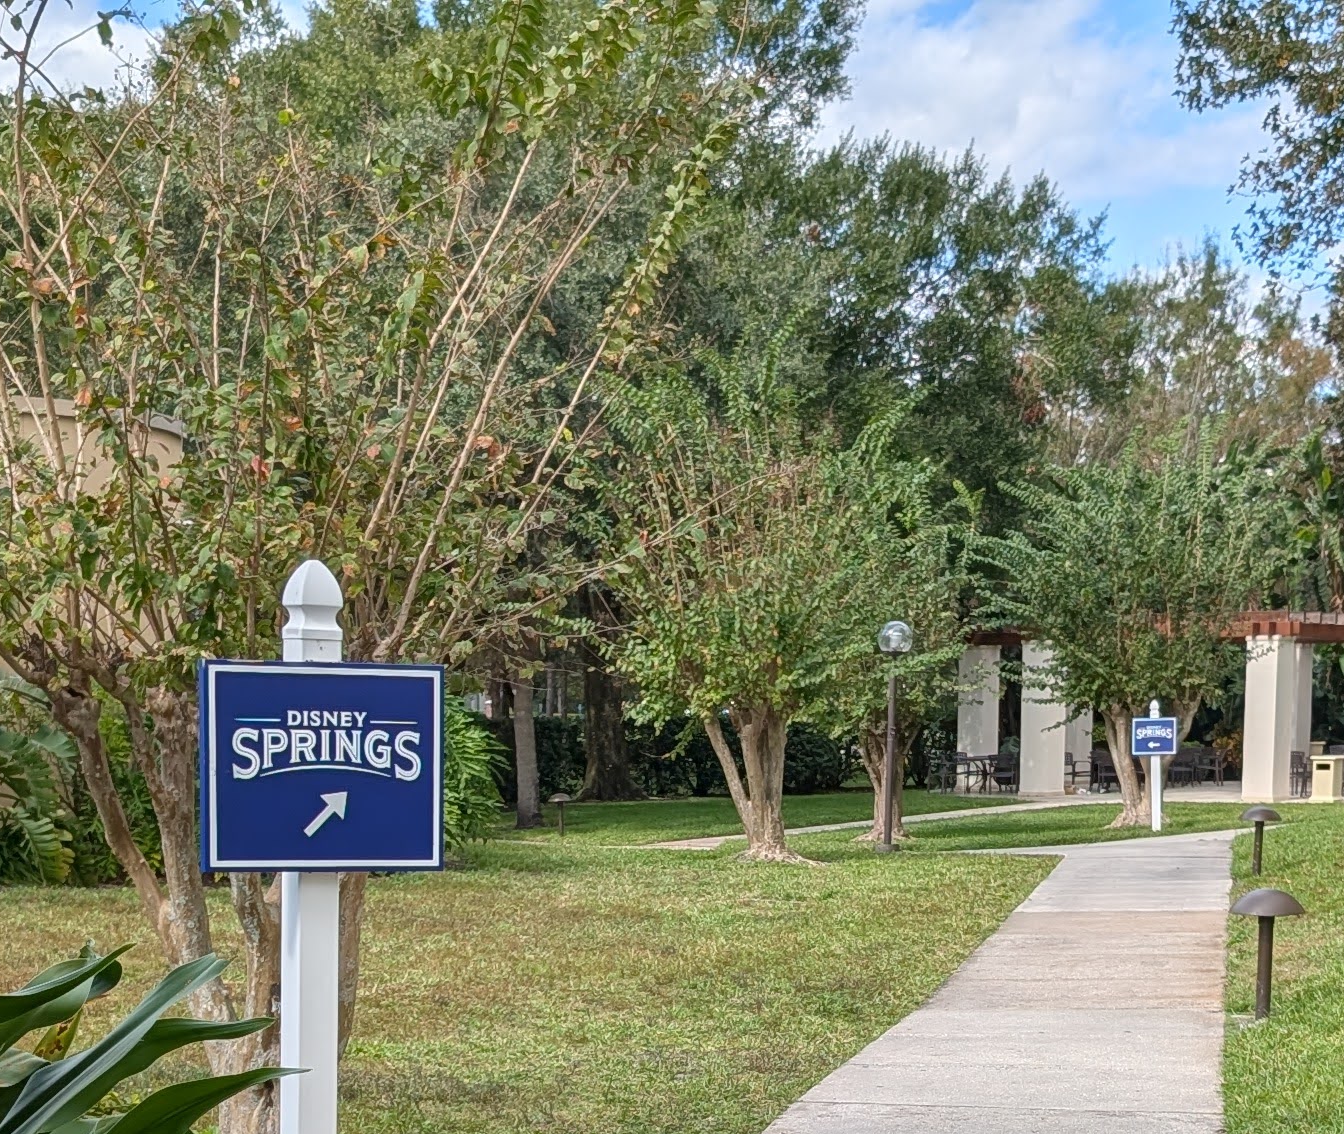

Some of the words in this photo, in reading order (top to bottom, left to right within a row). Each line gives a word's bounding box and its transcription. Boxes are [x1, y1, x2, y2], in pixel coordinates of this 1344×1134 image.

[287, 710, 367, 727] DISNEY
[1136, 728, 1172, 739] SPRINGS
[232, 727, 421, 781] SPRINGS
